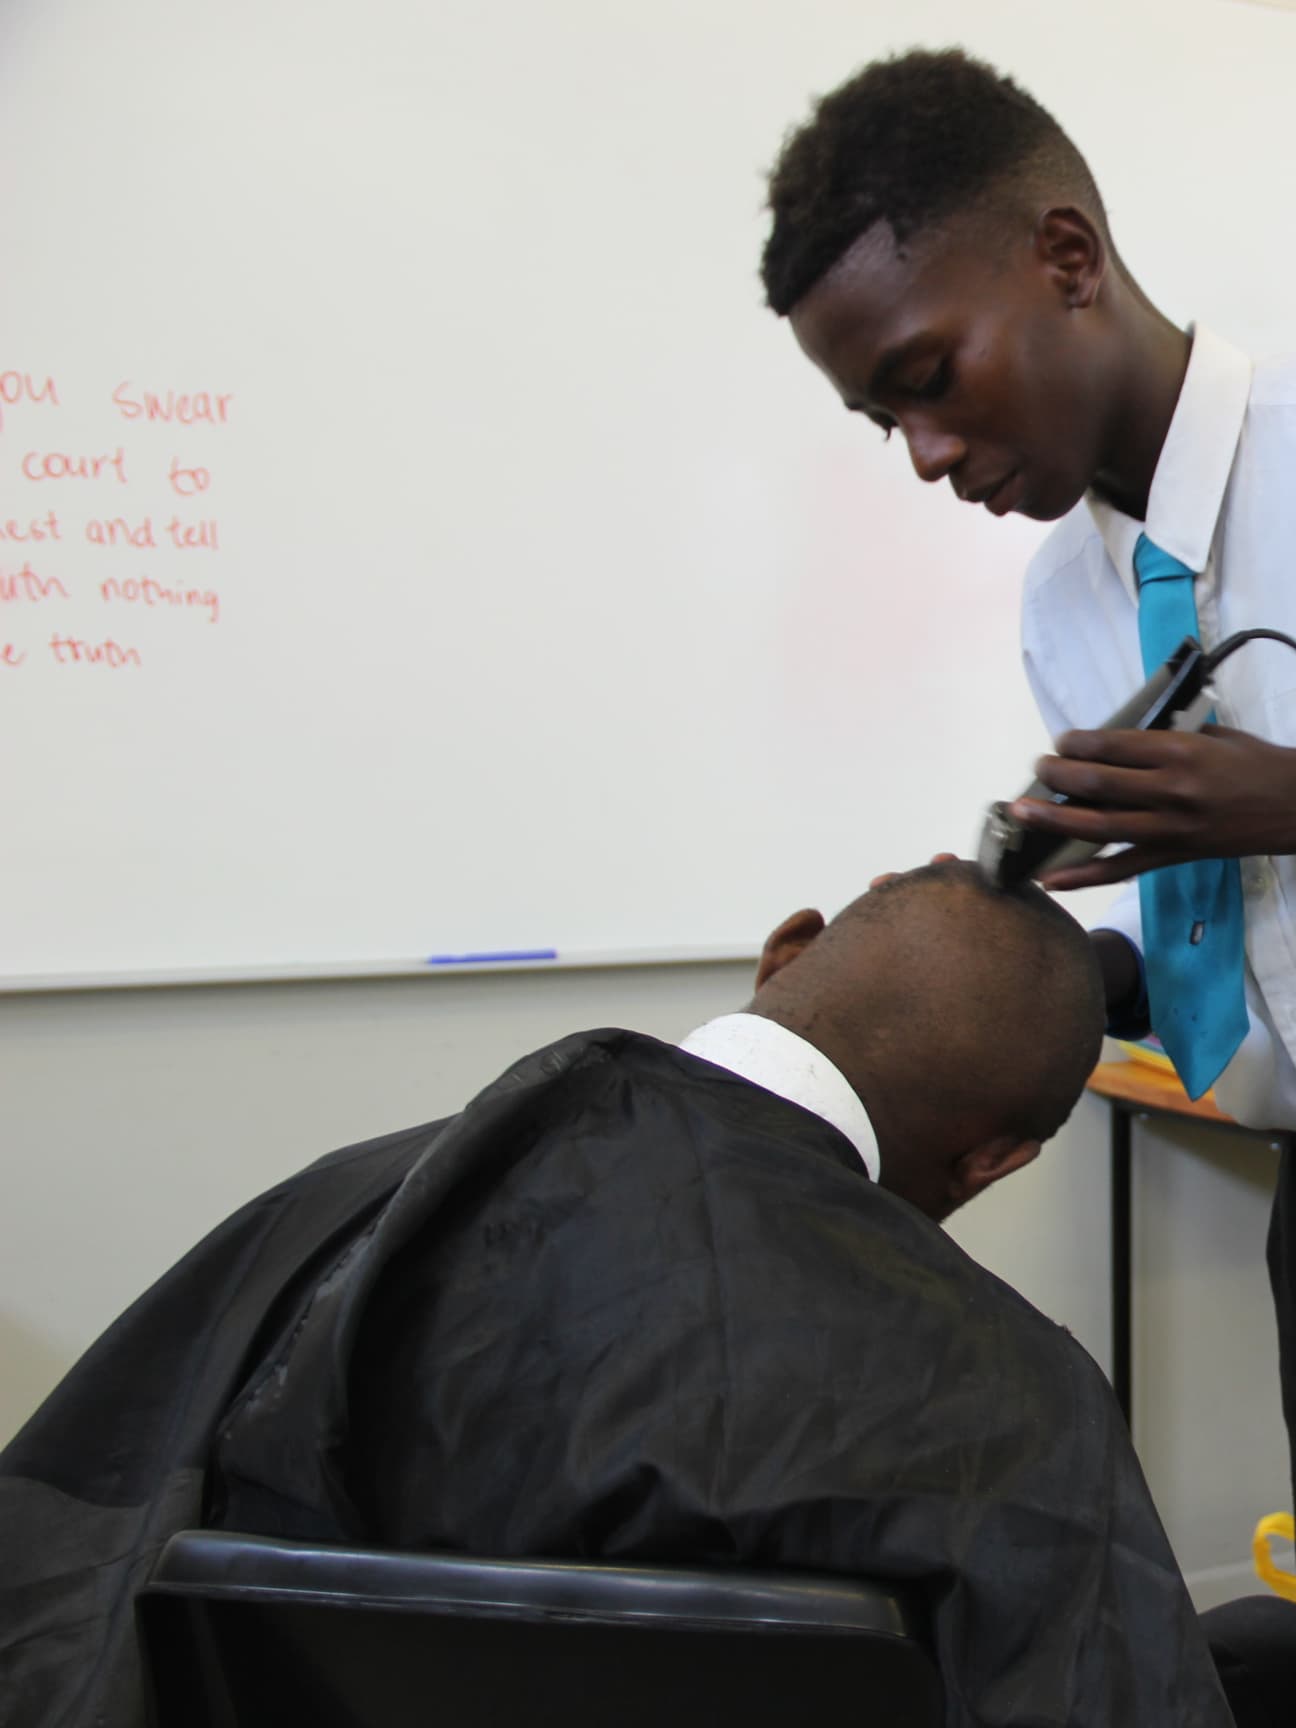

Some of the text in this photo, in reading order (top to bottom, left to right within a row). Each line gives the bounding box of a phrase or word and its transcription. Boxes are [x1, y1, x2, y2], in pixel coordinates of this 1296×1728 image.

[21, 447, 211, 497] court to
[85, 516, 157, 549] and
[165, 516, 220, 550] tell
[100, 576, 221, 624] nothing
[48, 633, 142, 669] truth
